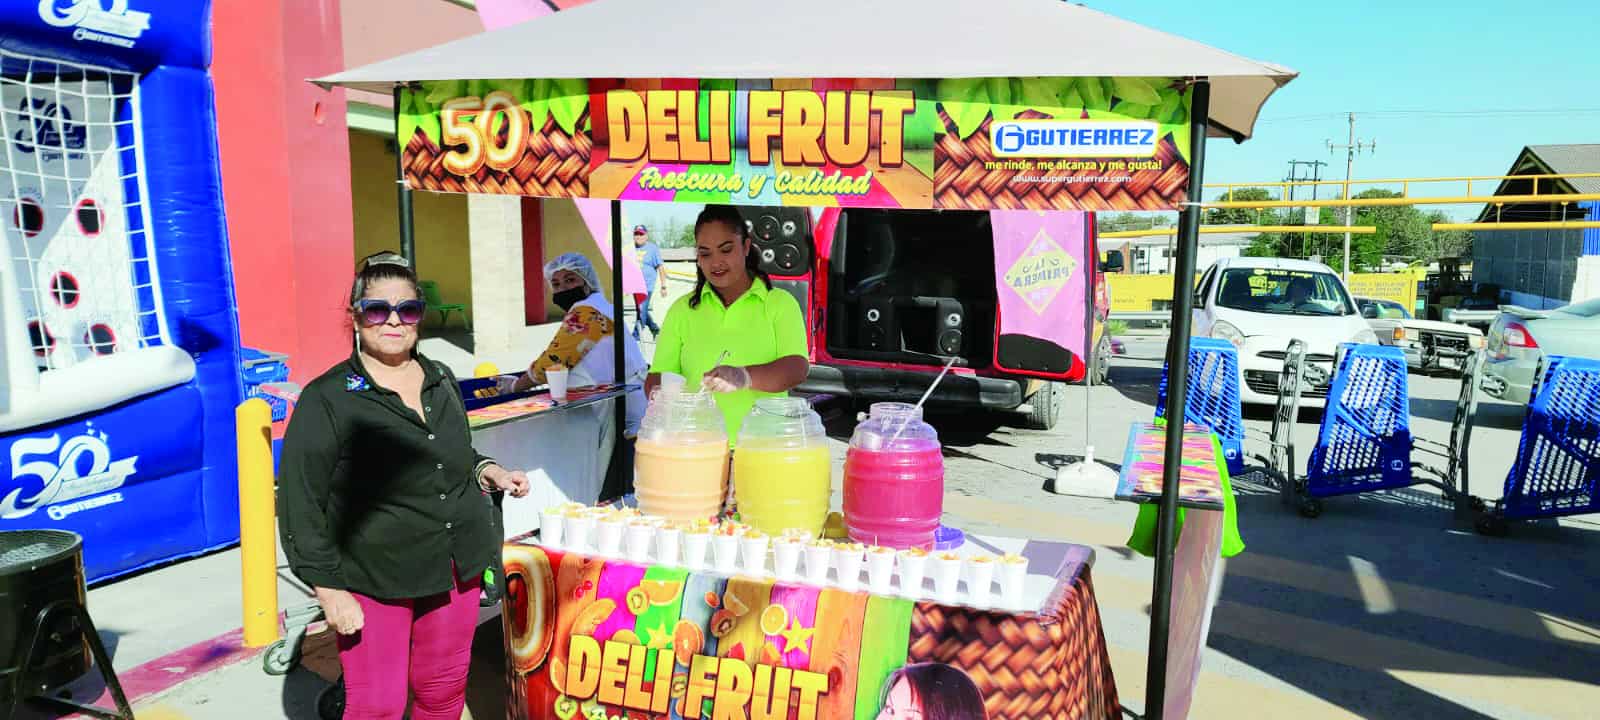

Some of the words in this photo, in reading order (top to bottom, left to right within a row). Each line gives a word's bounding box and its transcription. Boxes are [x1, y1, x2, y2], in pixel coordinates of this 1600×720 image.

[441, 91, 530, 176] 50
[606, 89, 732, 165] DELI
[748, 89, 917, 168] FRUT
[1026, 129, 1154, 147] GUTIERREZ
[638, 166, 743, 194] Frescura
[748, 171, 767, 198] y
[774, 170, 873, 196] Calidad
[985, 161, 1002, 170] me
[1004, 159, 1035, 172] rinde,
[1037, 161, 1054, 170] me
[1056, 159, 1097, 170] alcanza
[1099, 161, 1106, 173] y
[1108, 161, 1125, 170] me
[1129, 159, 1162, 173] gusta!
[1012, 174, 1132, 184] www.supergutierrez.com
[0, 432, 111, 519] 50
[565, 634, 676, 716] DELI
[682, 654, 831, 720] FRUT
